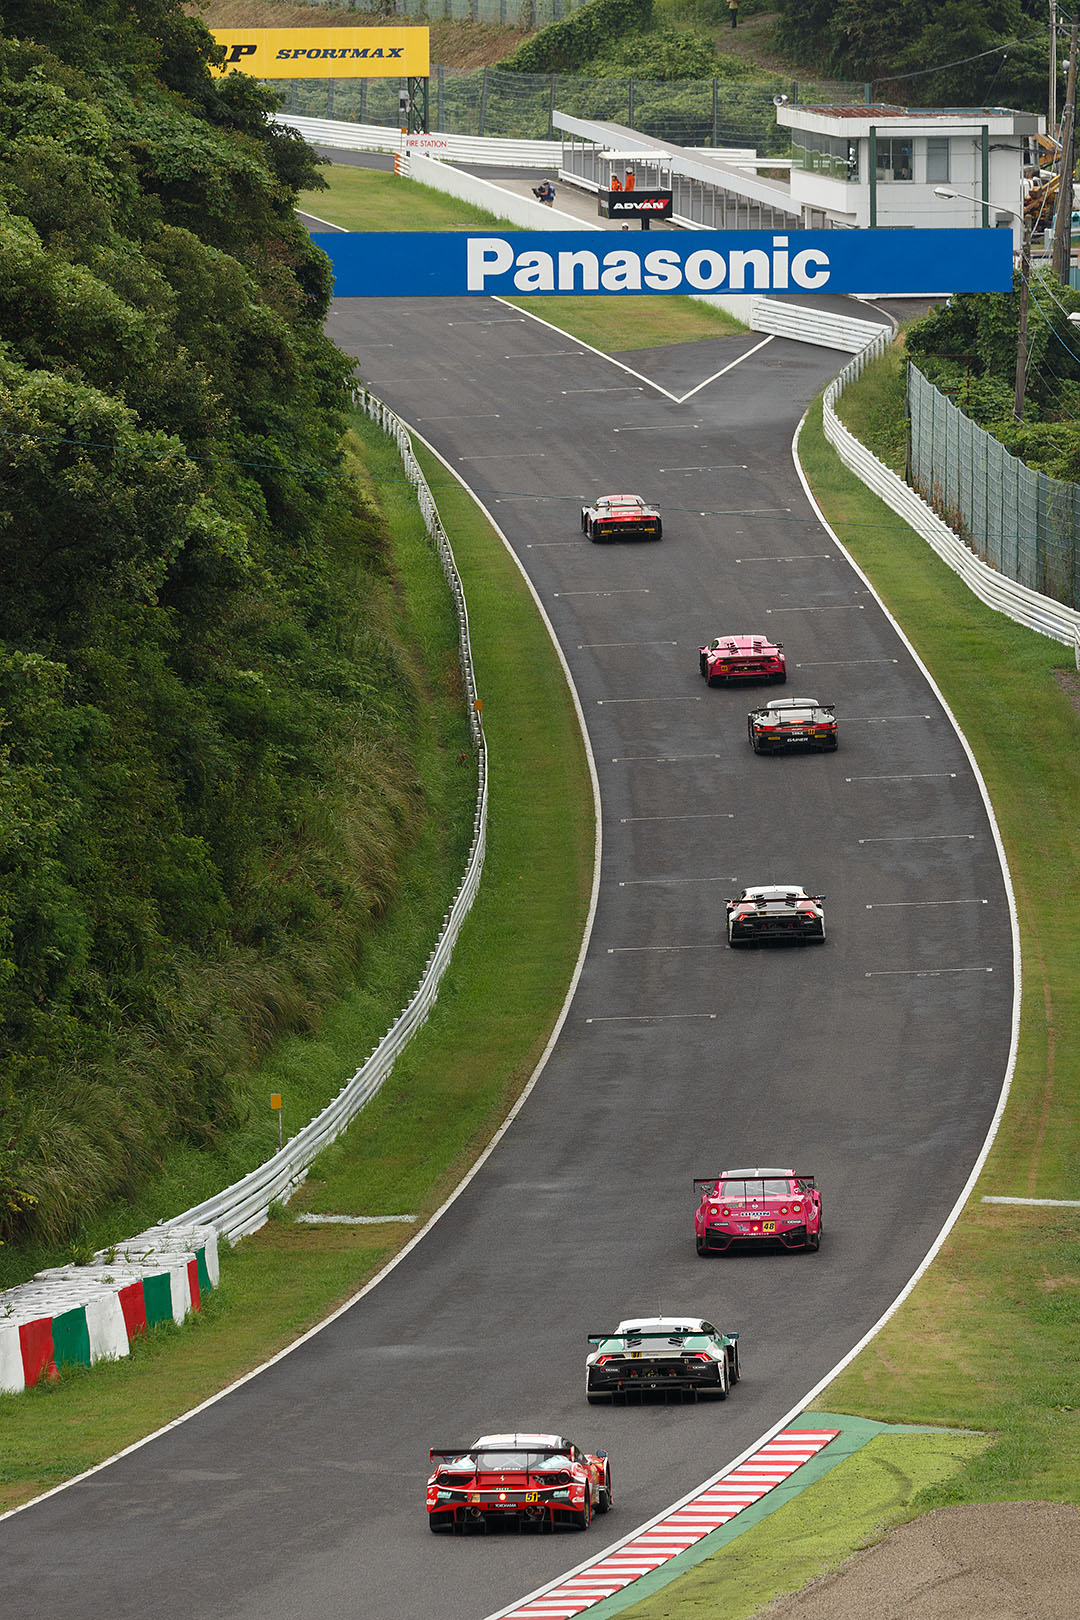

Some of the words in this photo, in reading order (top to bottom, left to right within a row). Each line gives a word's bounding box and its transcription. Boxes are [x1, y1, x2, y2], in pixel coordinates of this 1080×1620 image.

[276, 48, 404, 59] SPORTMAX
[420, 140, 447, 148] STATION
[613, 202, 664, 210] ADVAN
[467, 236, 830, 292] Panasonic
[526, 1493, 537, 1501] 51
